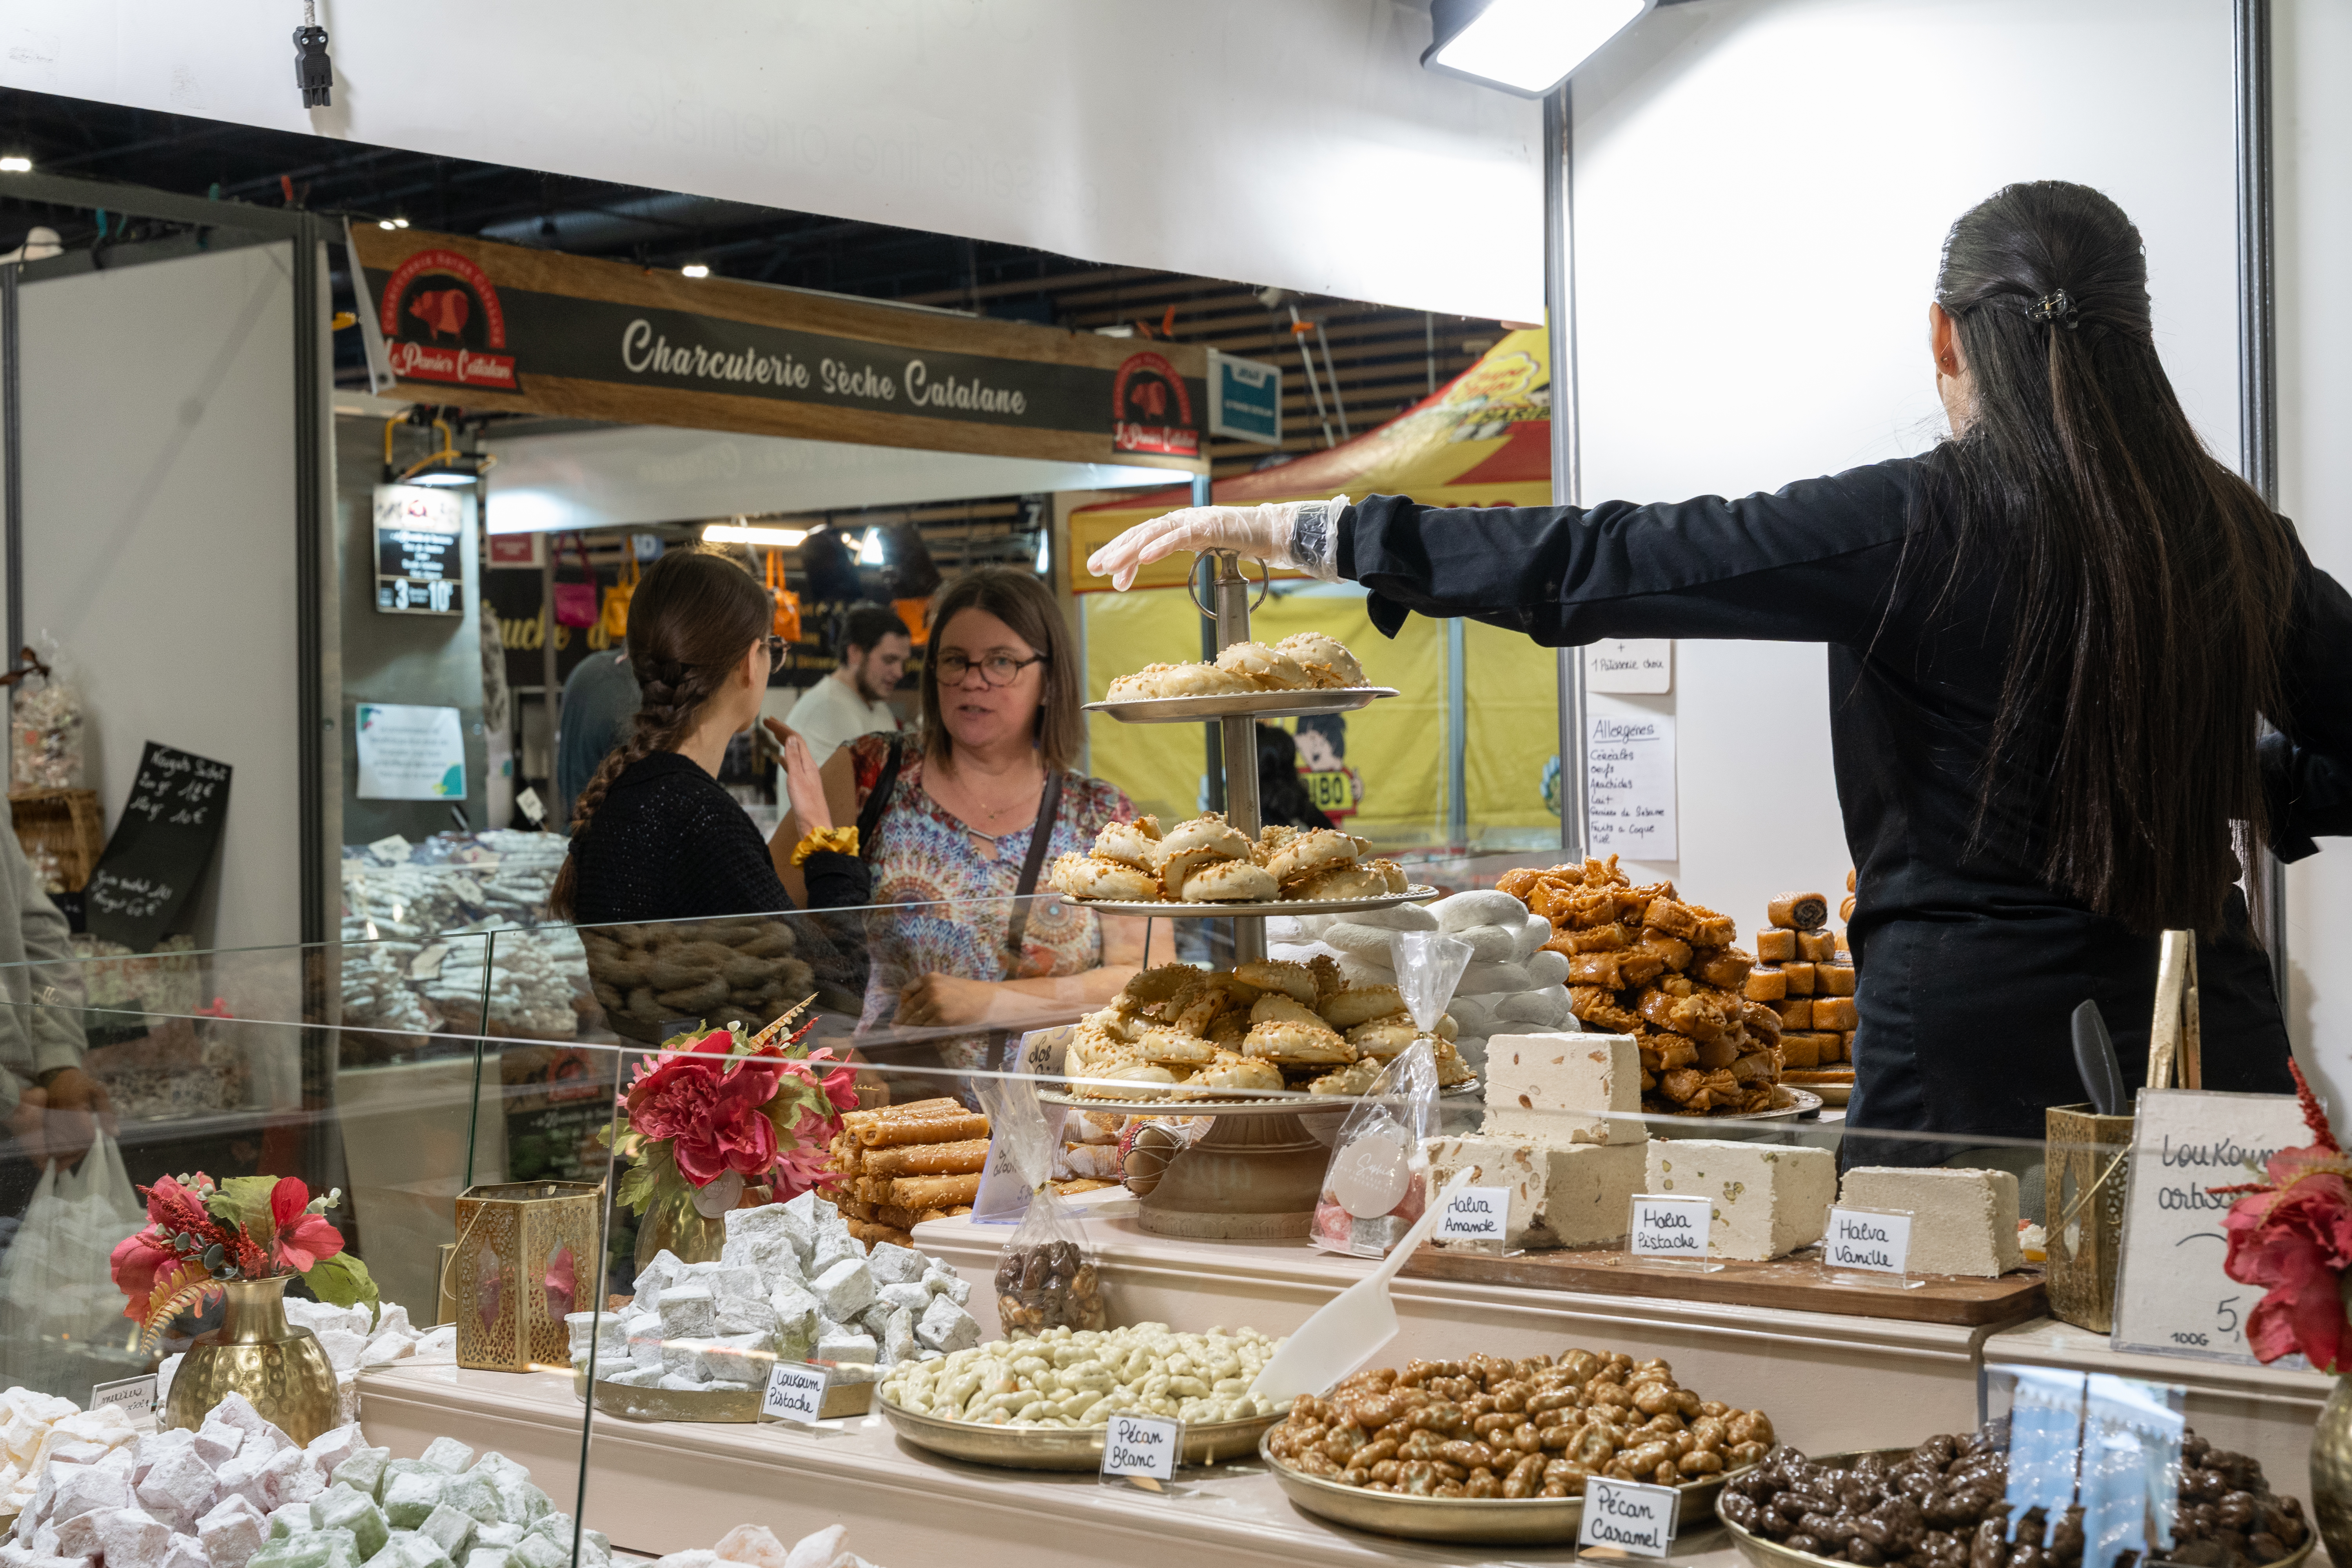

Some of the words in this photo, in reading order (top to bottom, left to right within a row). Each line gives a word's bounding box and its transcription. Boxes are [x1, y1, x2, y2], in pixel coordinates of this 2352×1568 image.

[622, 318, 810, 390] Charcuterie
[820, 355, 896, 401] Sèche
[904, 358, 1027, 416] Catalane
[1591, 658, 1598, 672] 1
[1590, 777, 1633, 795] Arachides
[1591, 795, 1614, 805] Lait
[1621, 807, 1630, 817] de
[1590, 820, 1613, 832] Fruits
[1629, 823, 1655, 839] Coque
[1447, 1196, 1493, 1214] Halva
[2158, 1181, 2234, 1210] artis
[1445, 1218, 1497, 1233] Amande
[1643, 1208, 1692, 1230] Halva
[1637, 1232, 1699, 1250] Pistache
[1840, 1219, 1889, 1243] Halva
[1835, 1246, 1893, 1268] Vanille
[777, 1369, 821, 1392] Loukoum
[769, 1386, 814, 1413] Pistache
[1118, 1419, 1163, 1444] Pécan
[1109, 1445, 1156, 1468] Blanc
[1597, 1485, 1655, 1520] Pécan
[1591, 1517, 1662, 1549] Caramel
